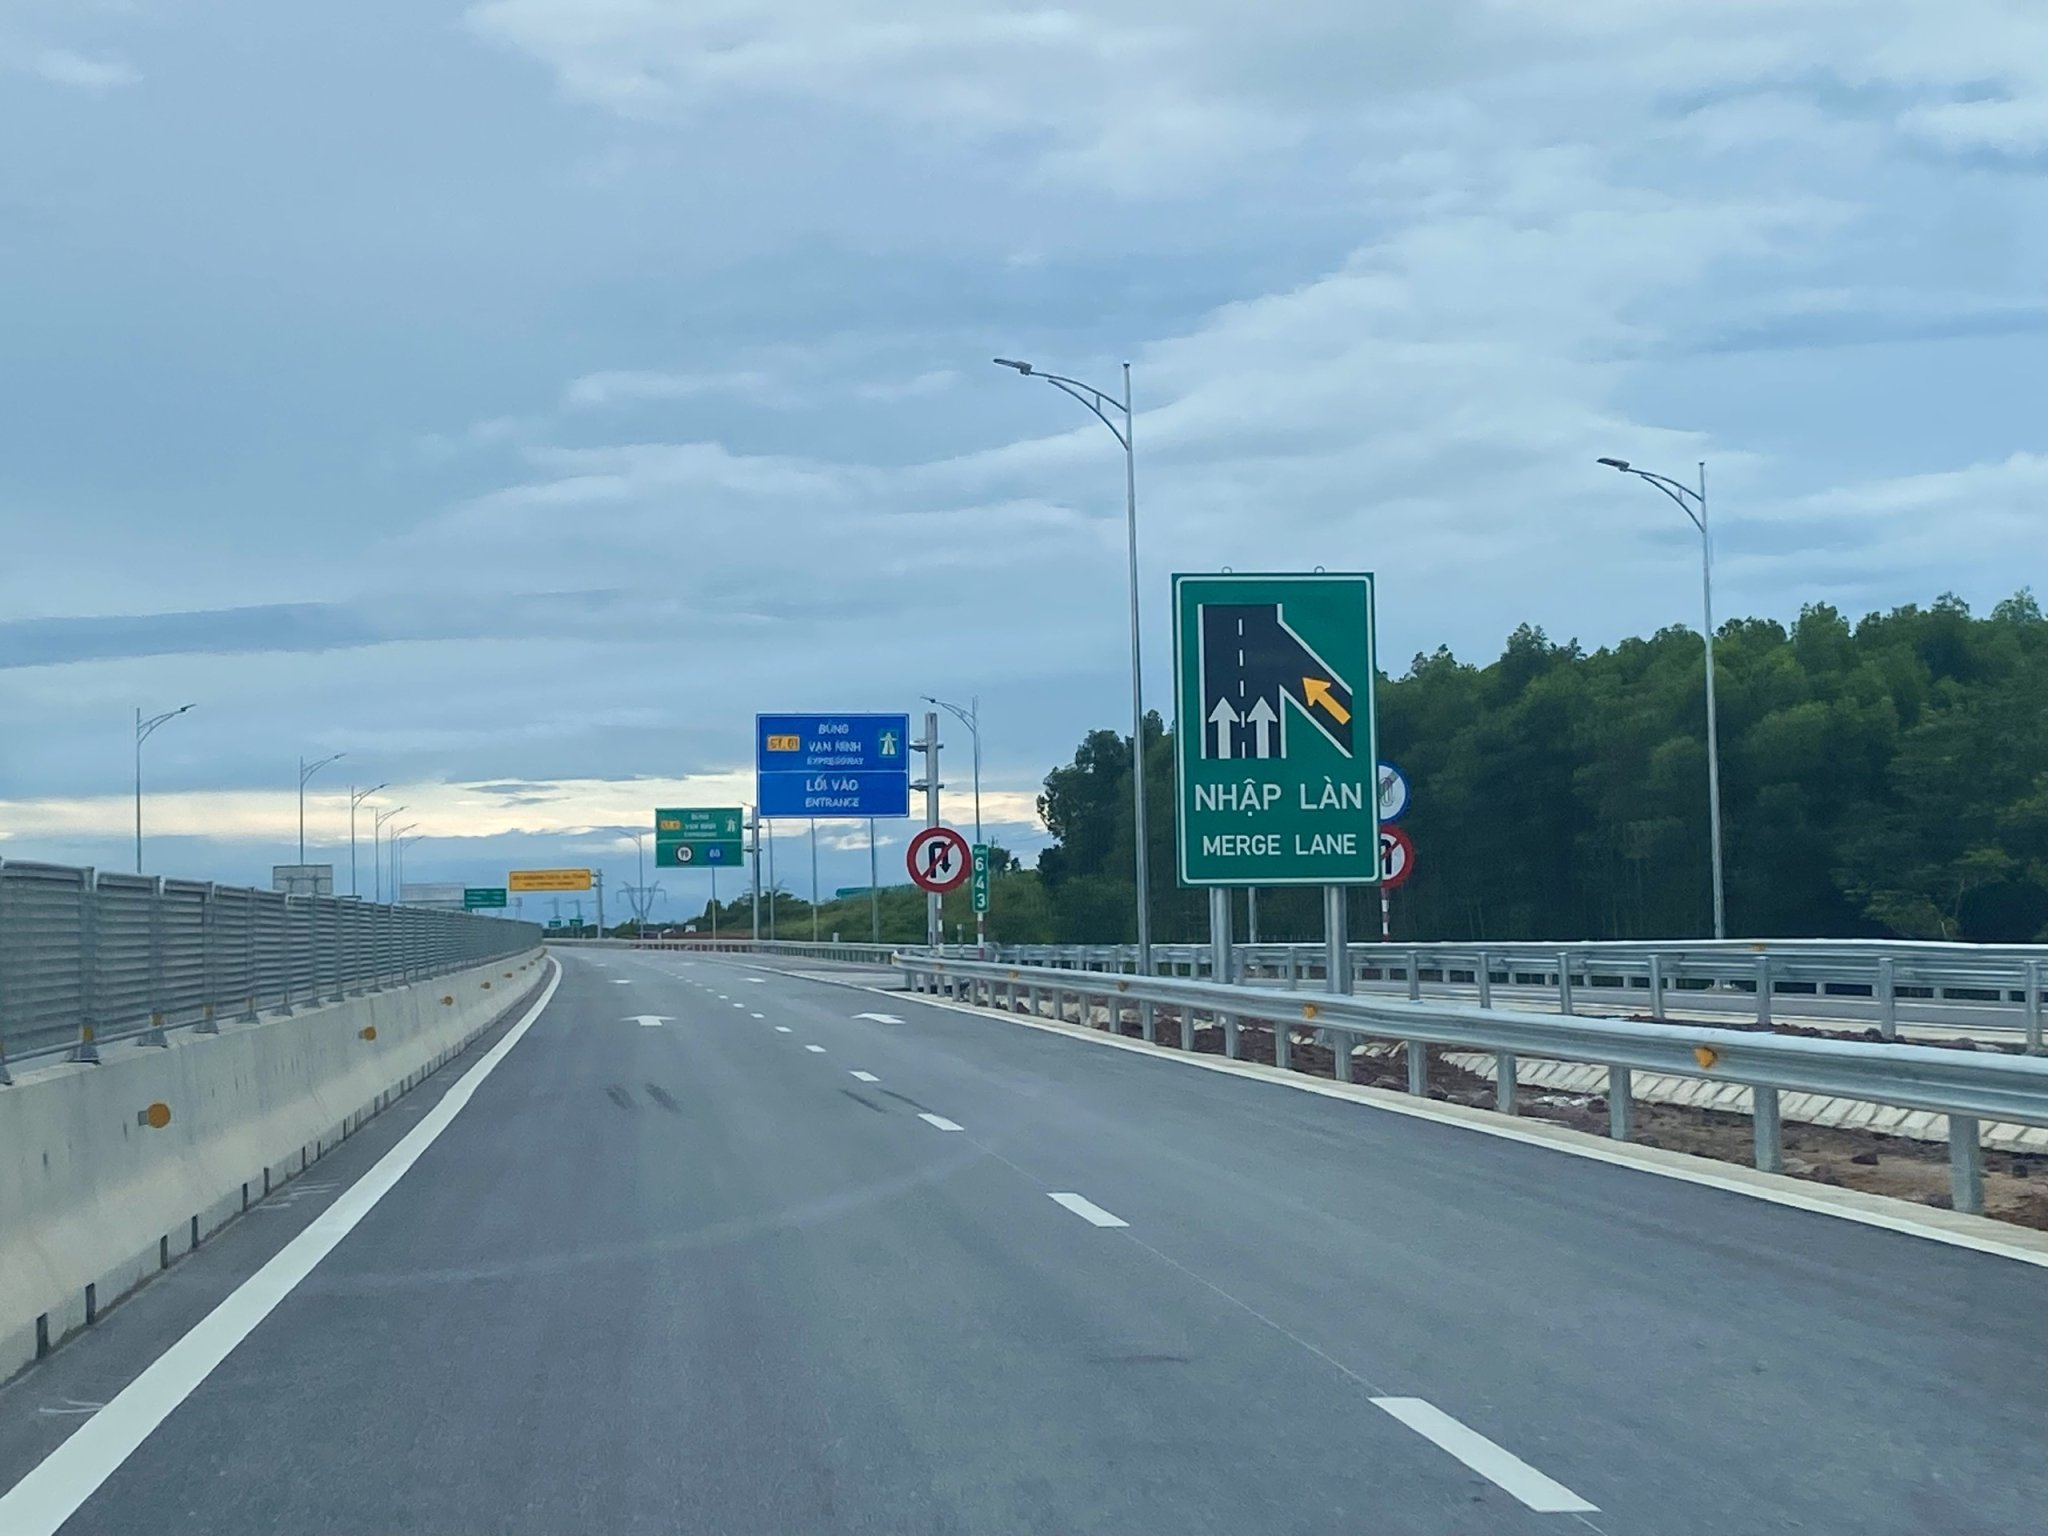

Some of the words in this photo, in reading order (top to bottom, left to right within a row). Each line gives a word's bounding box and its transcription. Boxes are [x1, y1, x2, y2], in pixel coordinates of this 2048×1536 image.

[805, 798, 860, 808] ENTRANCE
[1194, 778, 1282, 817] NHẬP
[1300, 775, 1363, 810] LÀN
[1203, 834, 1281, 856] MERGE
[1295, 834, 1357, 855] LANE
